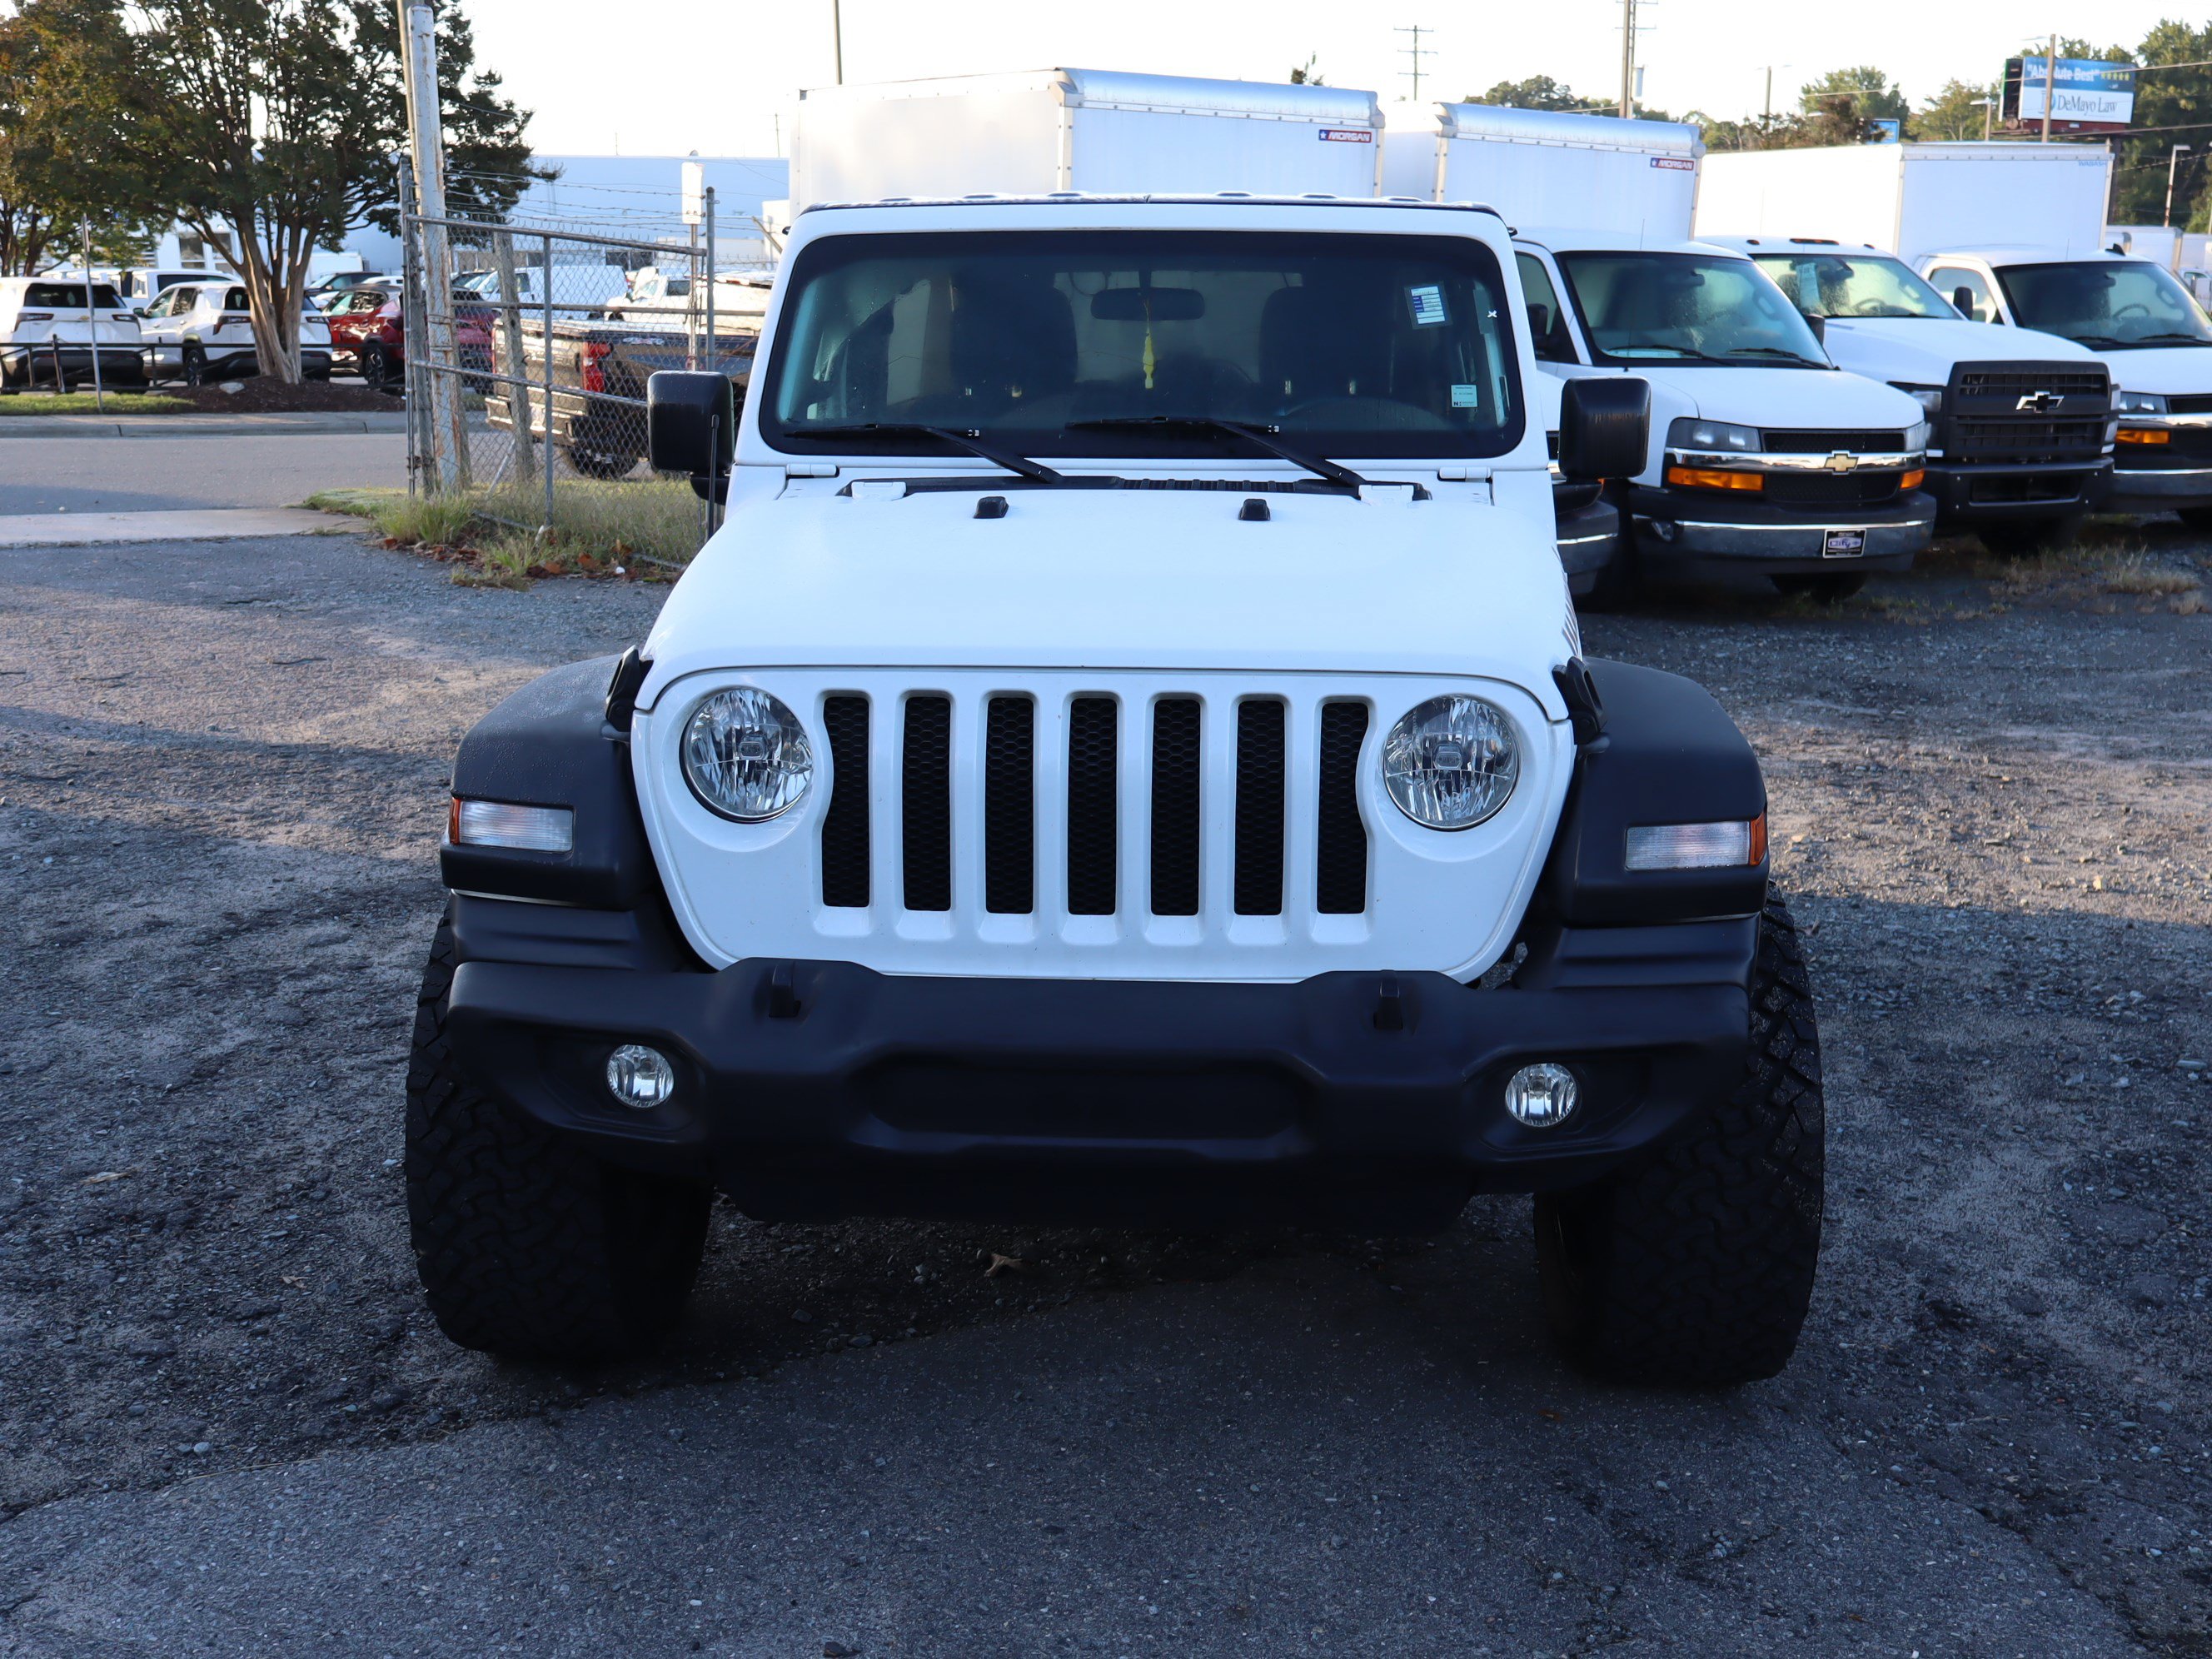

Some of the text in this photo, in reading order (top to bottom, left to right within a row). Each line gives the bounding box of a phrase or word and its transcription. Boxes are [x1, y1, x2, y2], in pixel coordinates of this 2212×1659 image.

[2058, 95, 2095, 116] DeMayo
[2098, 97, 2117, 113] Law
[1328, 131, 1371, 142] MORGAN
[1658, 159, 1693, 170] MORGAN
